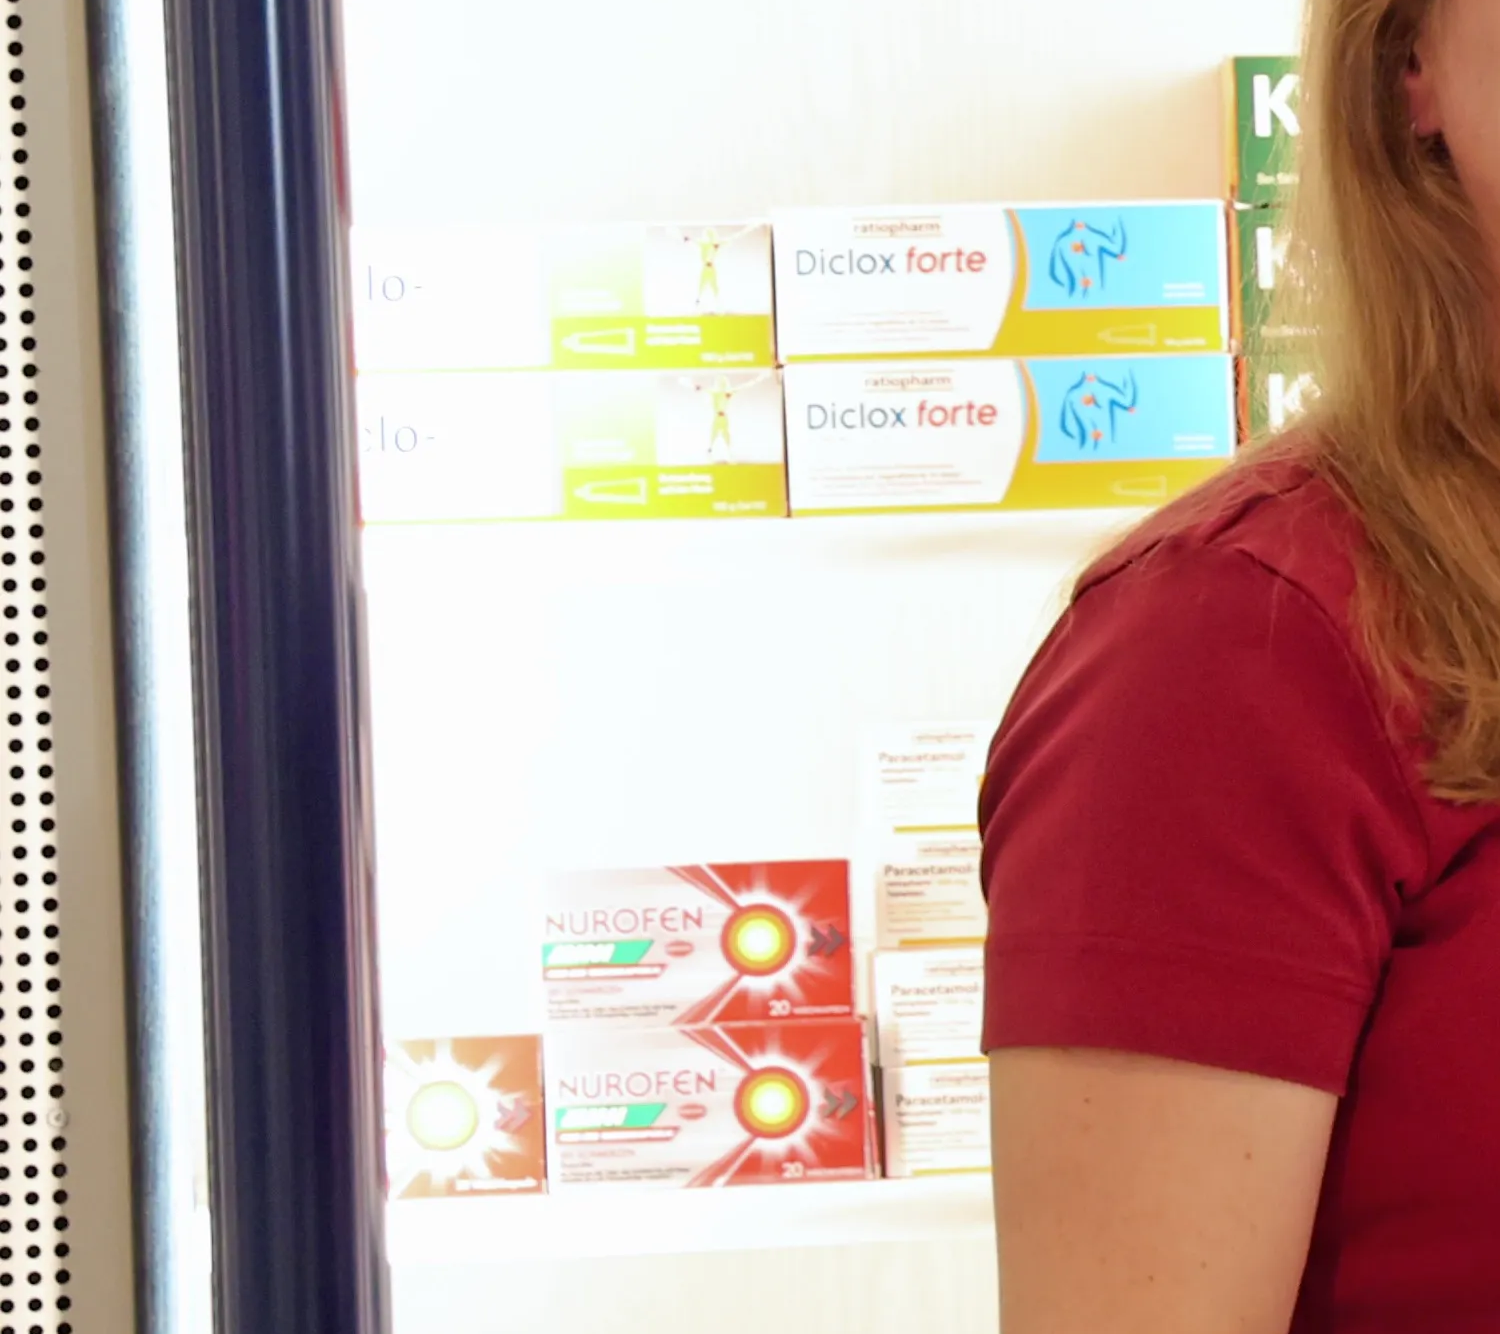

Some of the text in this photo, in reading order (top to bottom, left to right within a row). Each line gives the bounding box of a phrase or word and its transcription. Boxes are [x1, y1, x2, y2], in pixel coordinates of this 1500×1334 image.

[795, 246, 987, 276] Diclox forte
[807, 400, 998, 430] Diclox forte
[546, 905, 704, 936] NUROFEN
[768, 999, 791, 1017] 20
[558, 1069, 717, 1100] NUROFEN
[782, 1162, 805, 1179] 20
